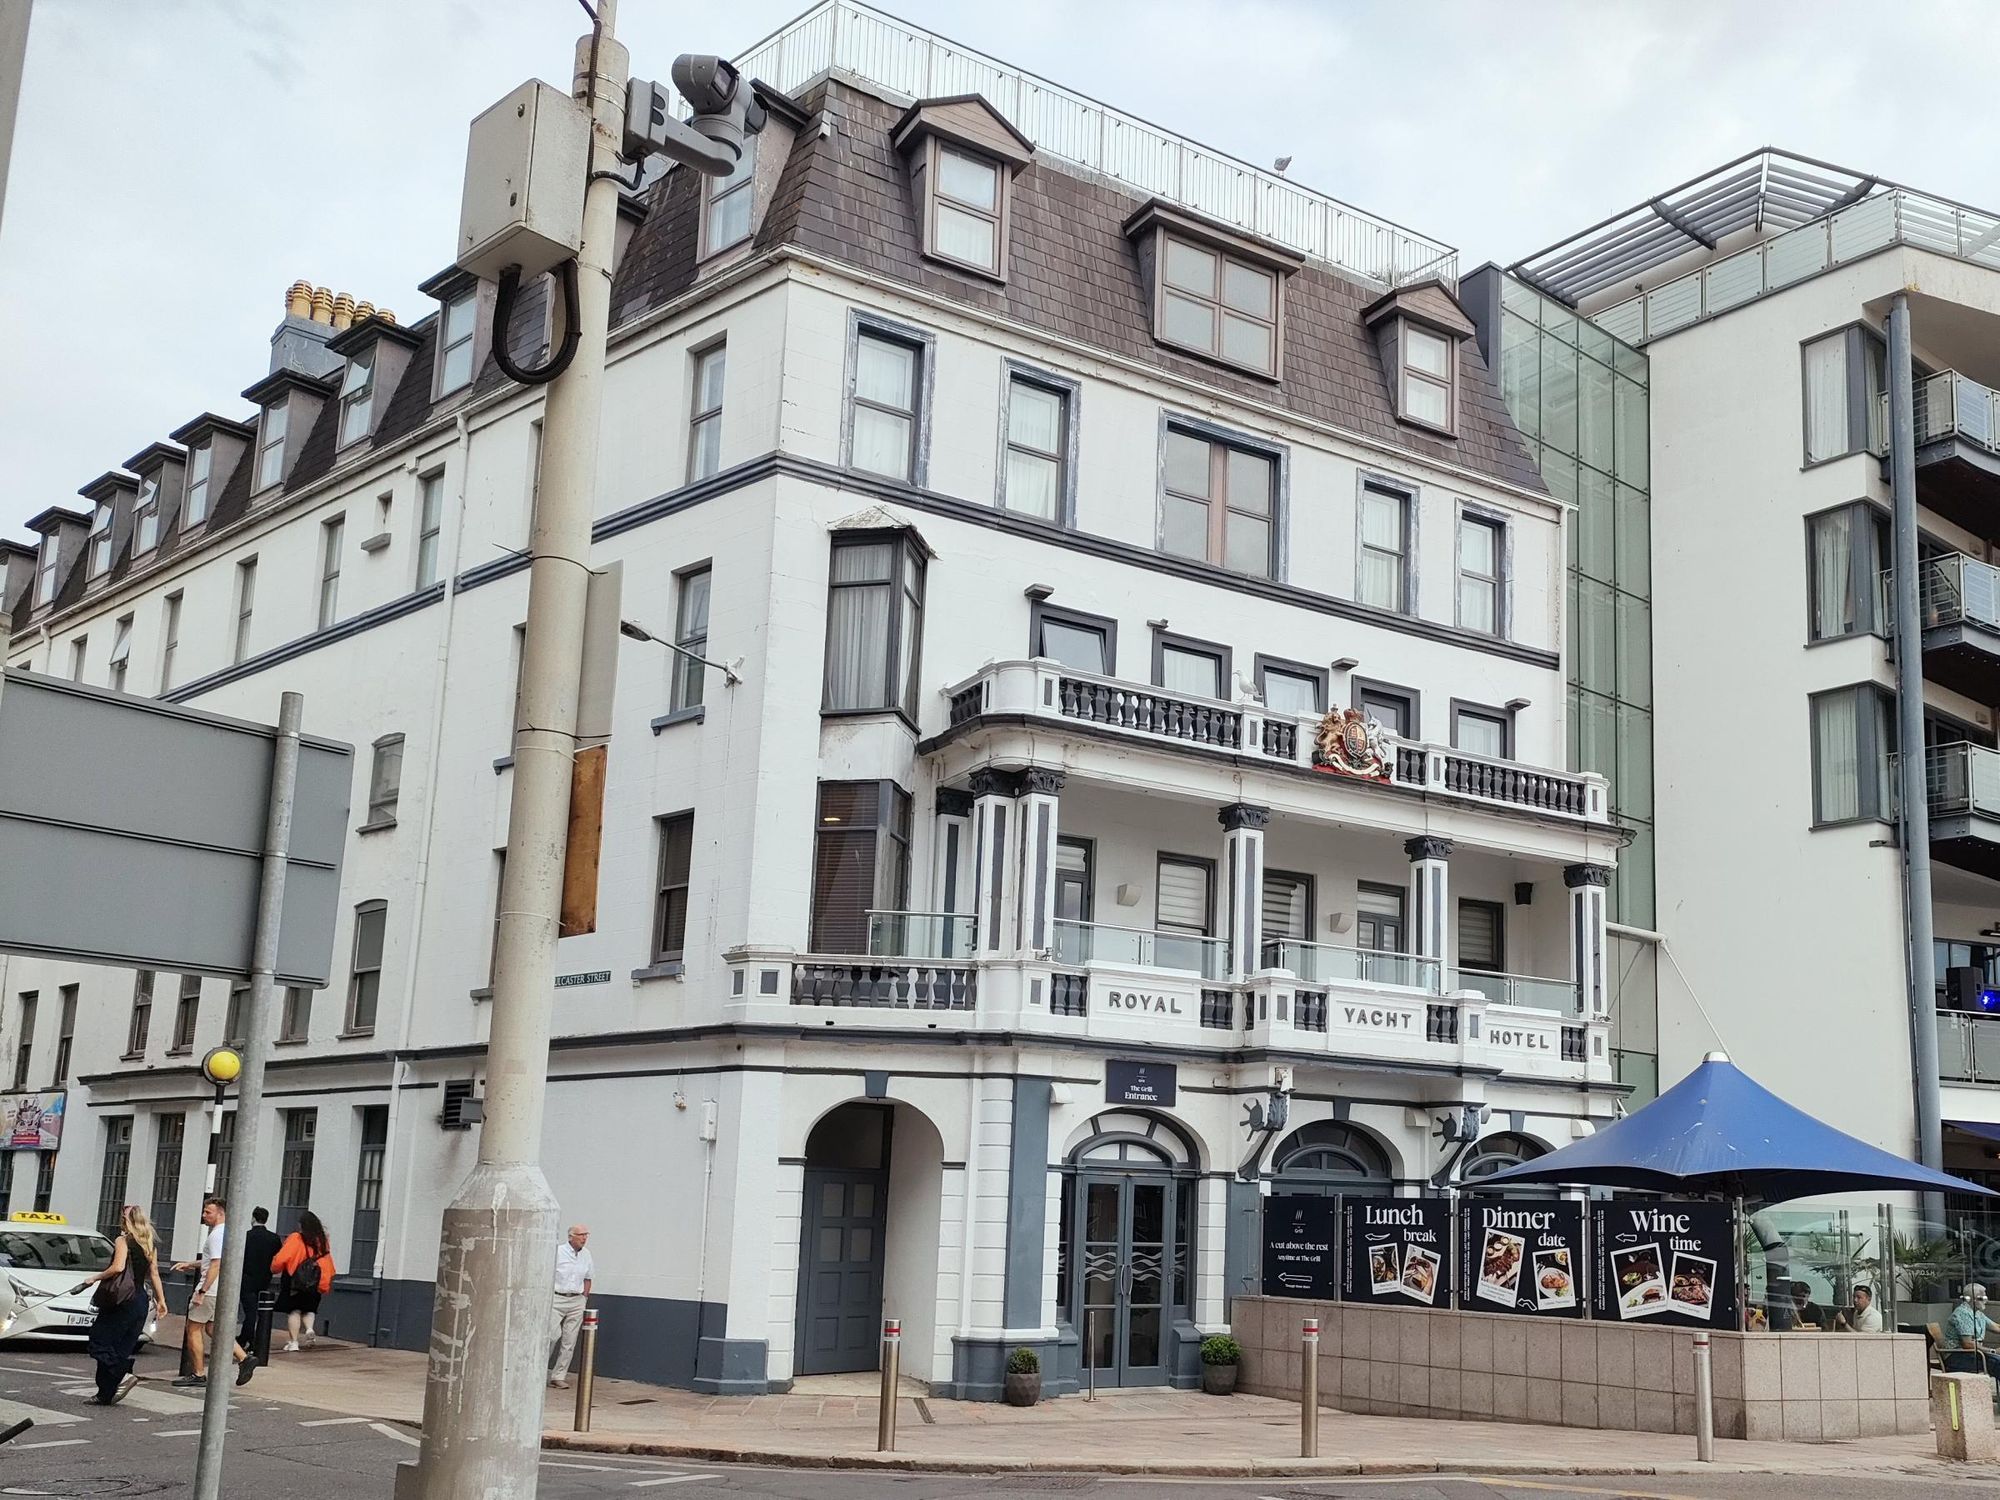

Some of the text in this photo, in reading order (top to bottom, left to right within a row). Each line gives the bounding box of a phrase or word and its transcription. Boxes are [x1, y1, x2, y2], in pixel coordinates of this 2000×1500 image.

[586, 972, 610, 983] STREET
[1108, 990, 1550, 1049] ROYAL YACHT HOTEL
[1124, 1091, 1158, 1101] Entrance
[17, 1212, 61, 1221] TAXI
[1365, 1203, 1424, 1226] Lunch
[1482, 1205, 1555, 1230] Dinner
[1629, 1208, 1690, 1233] Wine
[1403, 1228, 1437, 1242] break
[1538, 1232, 1566, 1247] date
[1269, 1241, 1329, 1251] A cut above the rest
[1669, 1235, 1702, 1251] time
